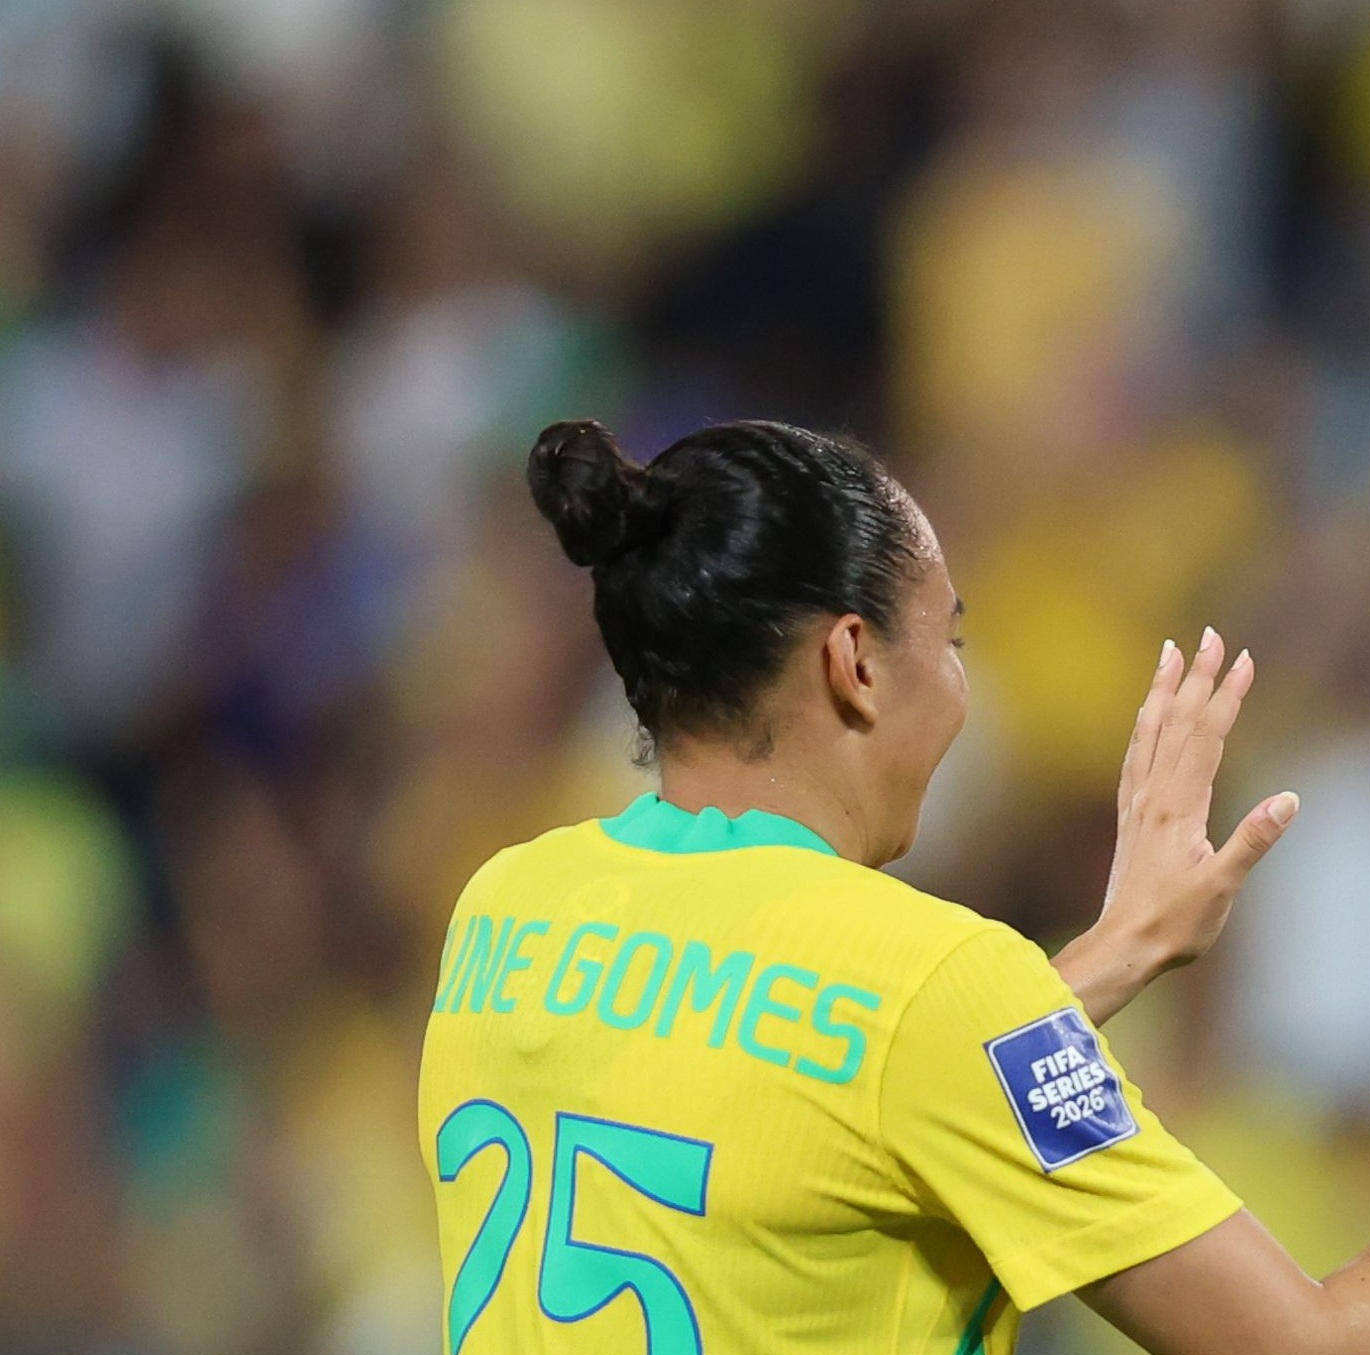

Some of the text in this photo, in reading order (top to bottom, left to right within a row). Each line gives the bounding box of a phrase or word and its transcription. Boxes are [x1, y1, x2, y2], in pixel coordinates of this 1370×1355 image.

[543, 921, 883, 1085] GOMES
[1026, 1061, 1107, 1113] SERIES
[1030, 1045, 1087, 1084] FIFA
[1050, 1085, 1105, 1130] 2026
